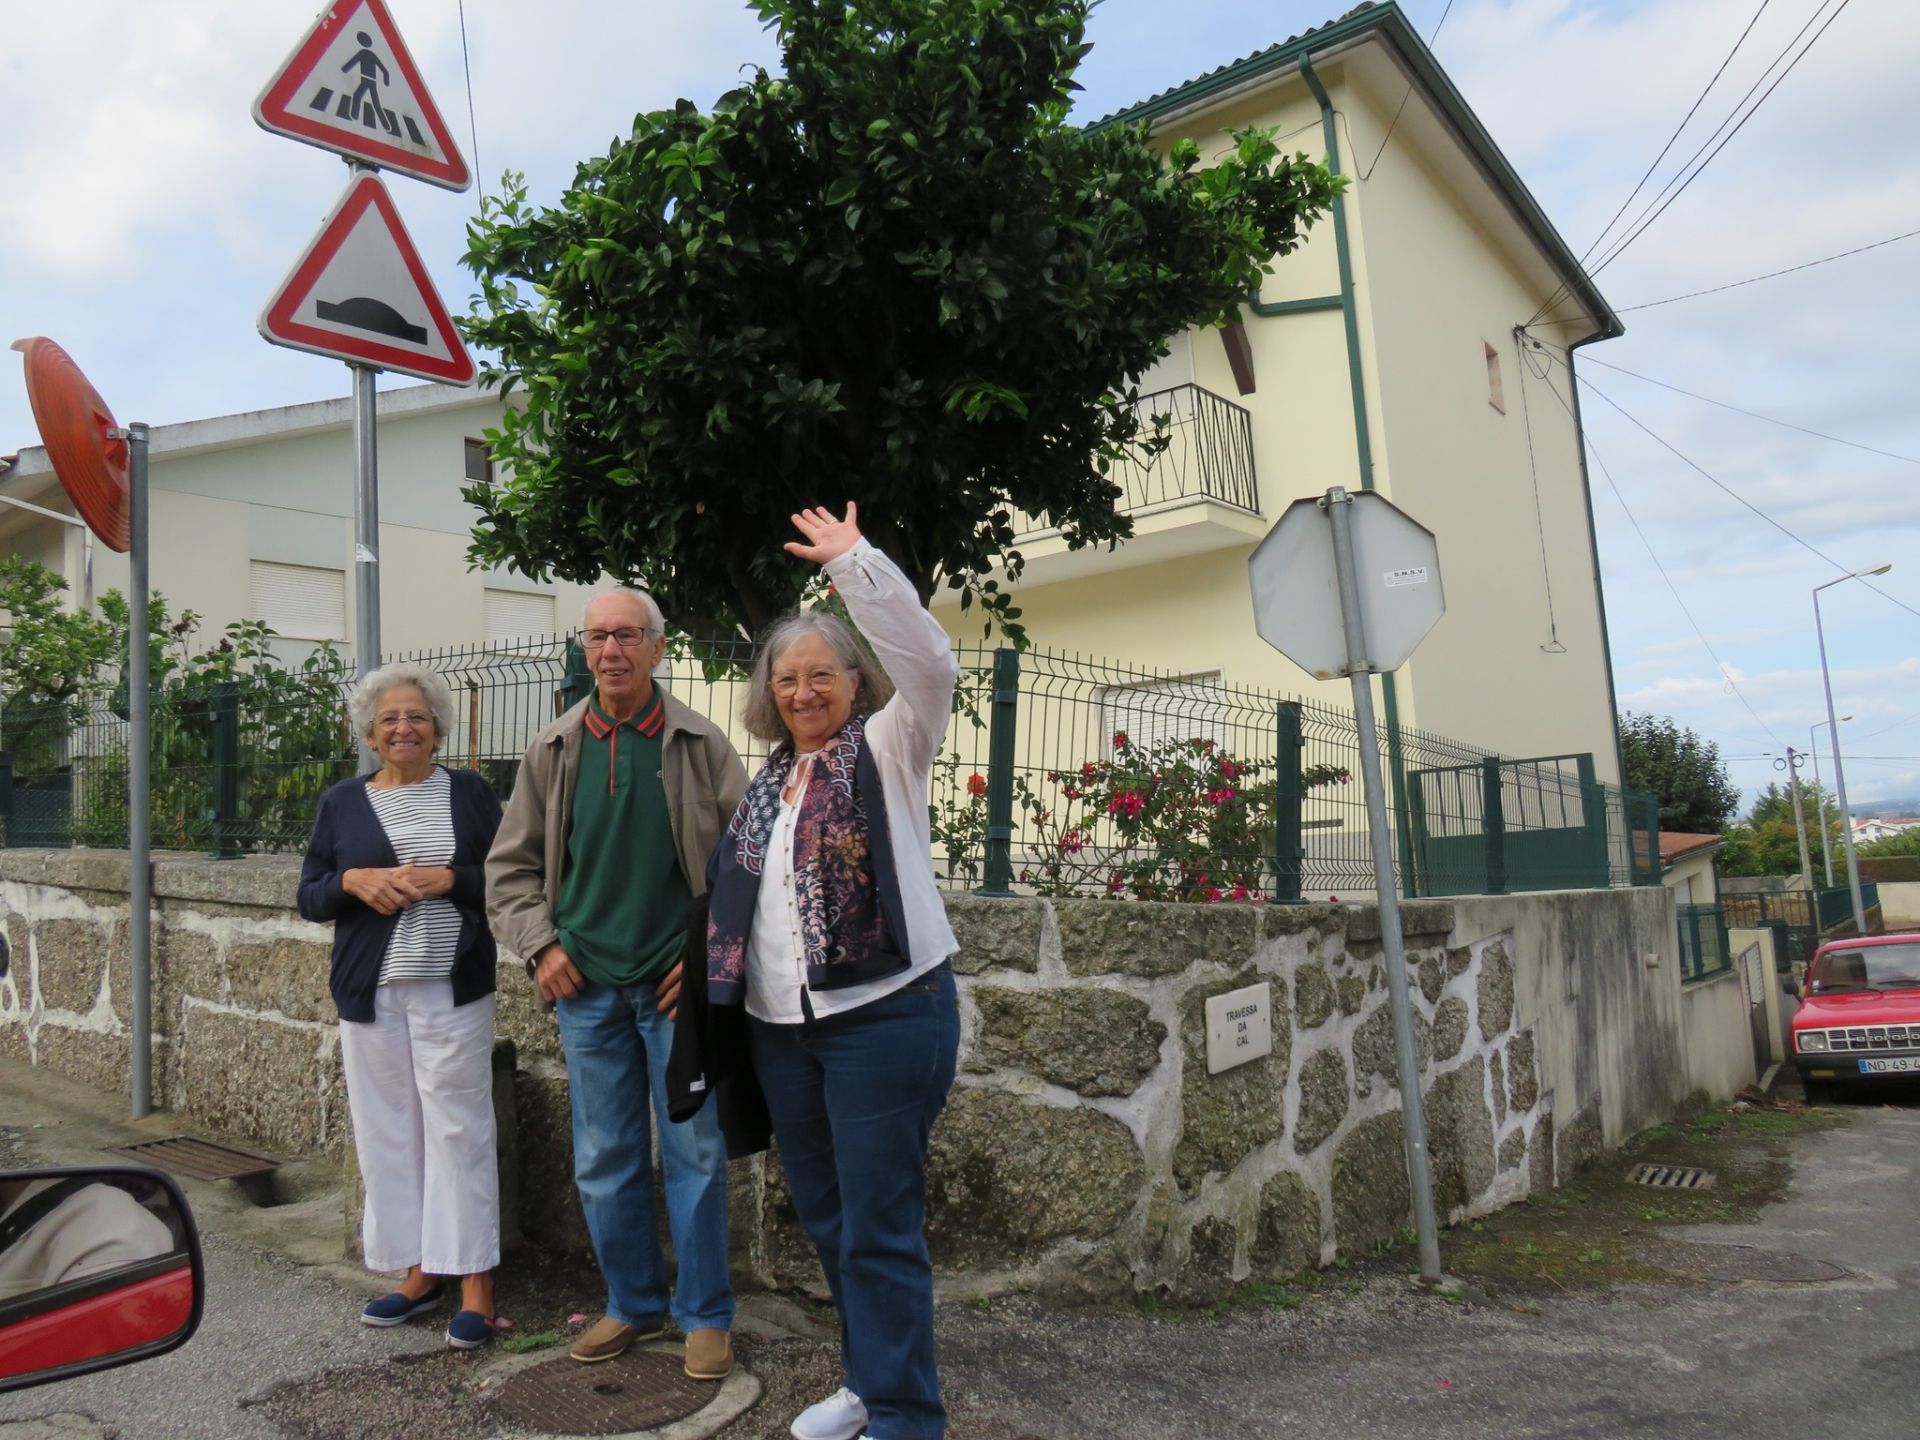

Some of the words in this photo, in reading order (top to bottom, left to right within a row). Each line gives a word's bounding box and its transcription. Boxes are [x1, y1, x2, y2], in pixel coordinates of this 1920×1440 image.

[1226, 1004, 1258, 1023] TRAVESSA
[1237, 1021, 1247, 1033] DA
[1236, 1035, 1249, 1047] CAL
